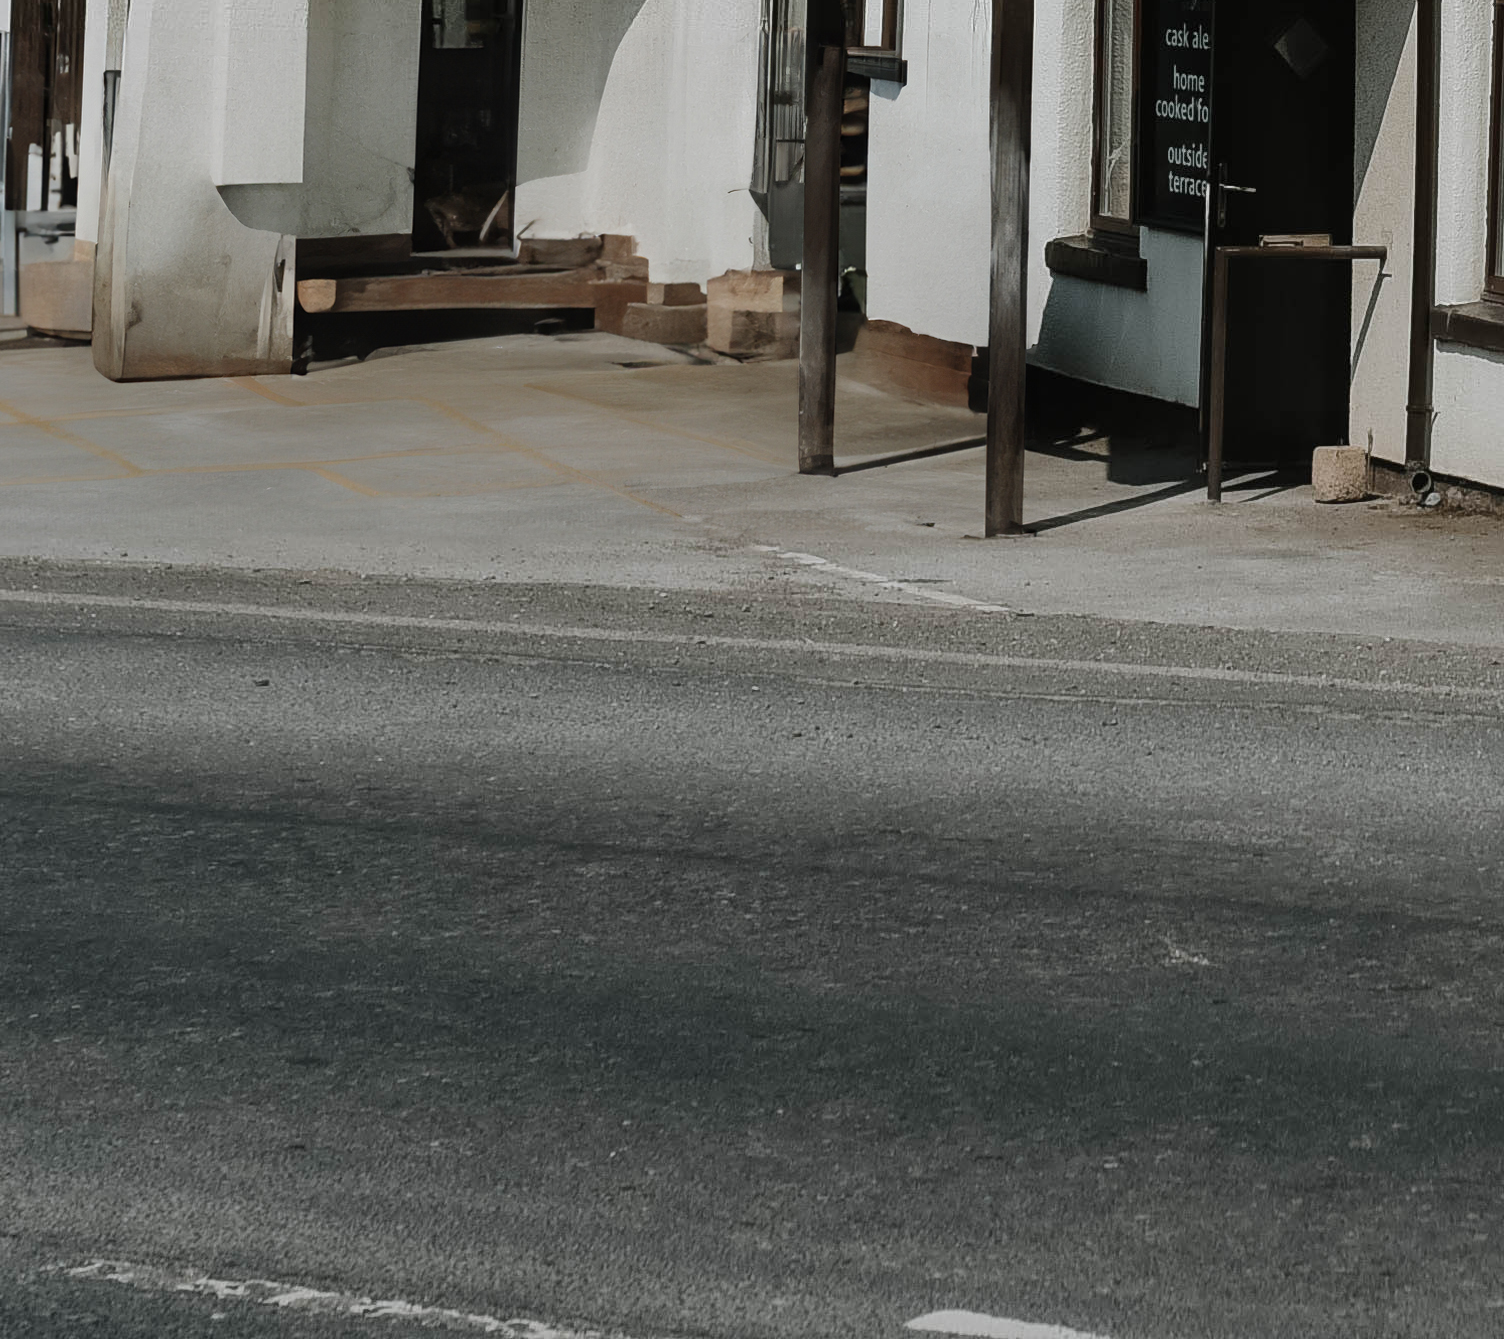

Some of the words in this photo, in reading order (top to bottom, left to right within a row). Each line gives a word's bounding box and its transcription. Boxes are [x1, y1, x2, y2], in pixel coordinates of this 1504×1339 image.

[1165, 22, 1189, 48] cask
[1192, 24, 1211, 50] ale
[1173, 64, 1205, 93] home
[1155, 94, 1194, 122] cooked
[1196, 97, 1209, 123] fo
[1167, 143, 1208, 169] outside
[1168, 170, 1208, 198] terrace
